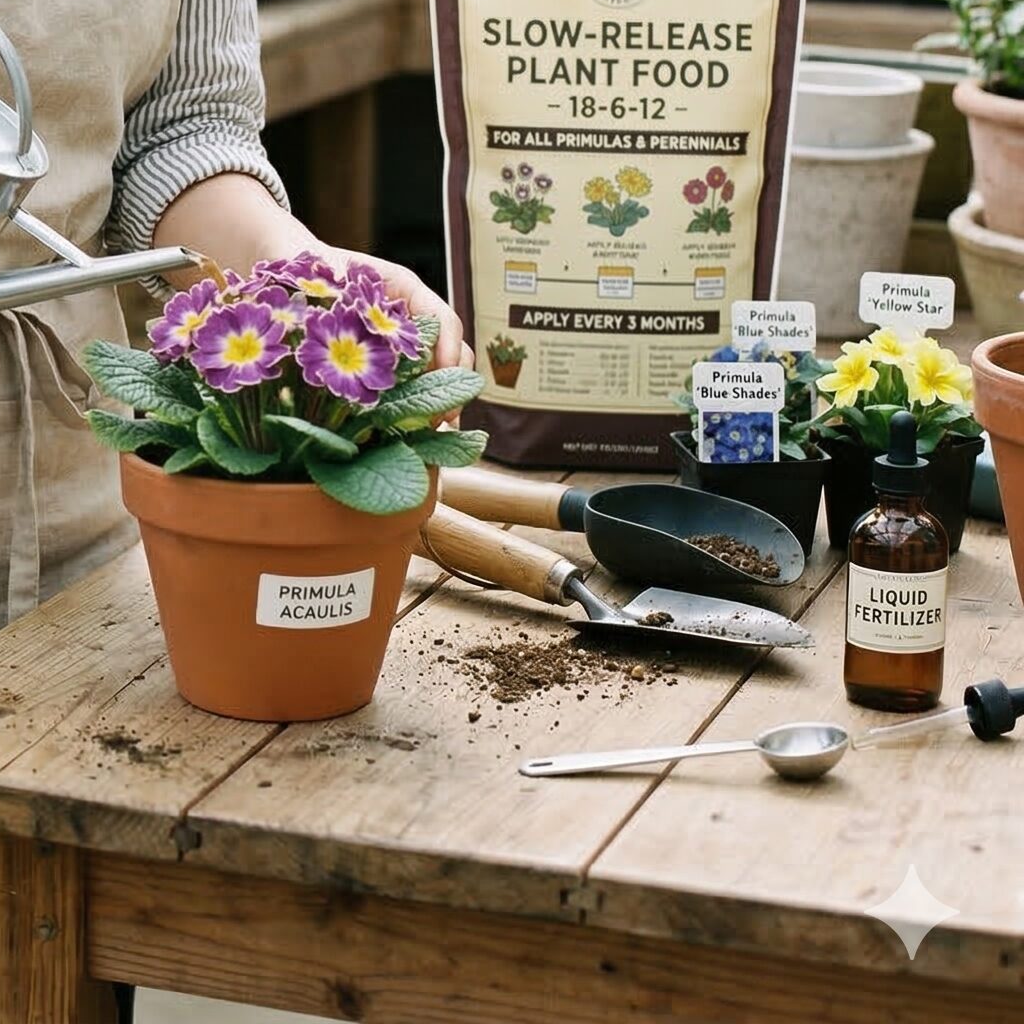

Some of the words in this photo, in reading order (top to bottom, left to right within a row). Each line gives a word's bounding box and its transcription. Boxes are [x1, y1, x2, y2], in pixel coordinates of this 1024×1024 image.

[482, 18, 753, 52] SLOW-RELEASE
[507, 56, 619, 87] PLANT
[632, 60, 730, 89] FOOD
[493, 130, 519, 145] FOR
[524, 132, 551, 147] ALL
[556, 133, 632, 149] PRIMULAS
[635, 136, 646, 149] &
[649, 135, 741, 151] PERENNIALS
[882, 283, 930, 297] Primula
[522, 310, 570, 328] APPLY
[574, 313, 623, 331] EVERY
[627, 314, 636, 331] 3
[640, 315, 705, 331] MONTHS
[750, 310, 796, 322] Primula
[712, 371, 763, 384] Primula
[696, 387, 729, 399] 'Blue
[732, 386, 781, 400] Shades'
[279, 583, 356, 600] PRIMULA
[870, 587, 928, 607] LIQUID
[280, 602, 353, 619] ACAULIS
[855, 604, 942, 626] FERTILIZER
